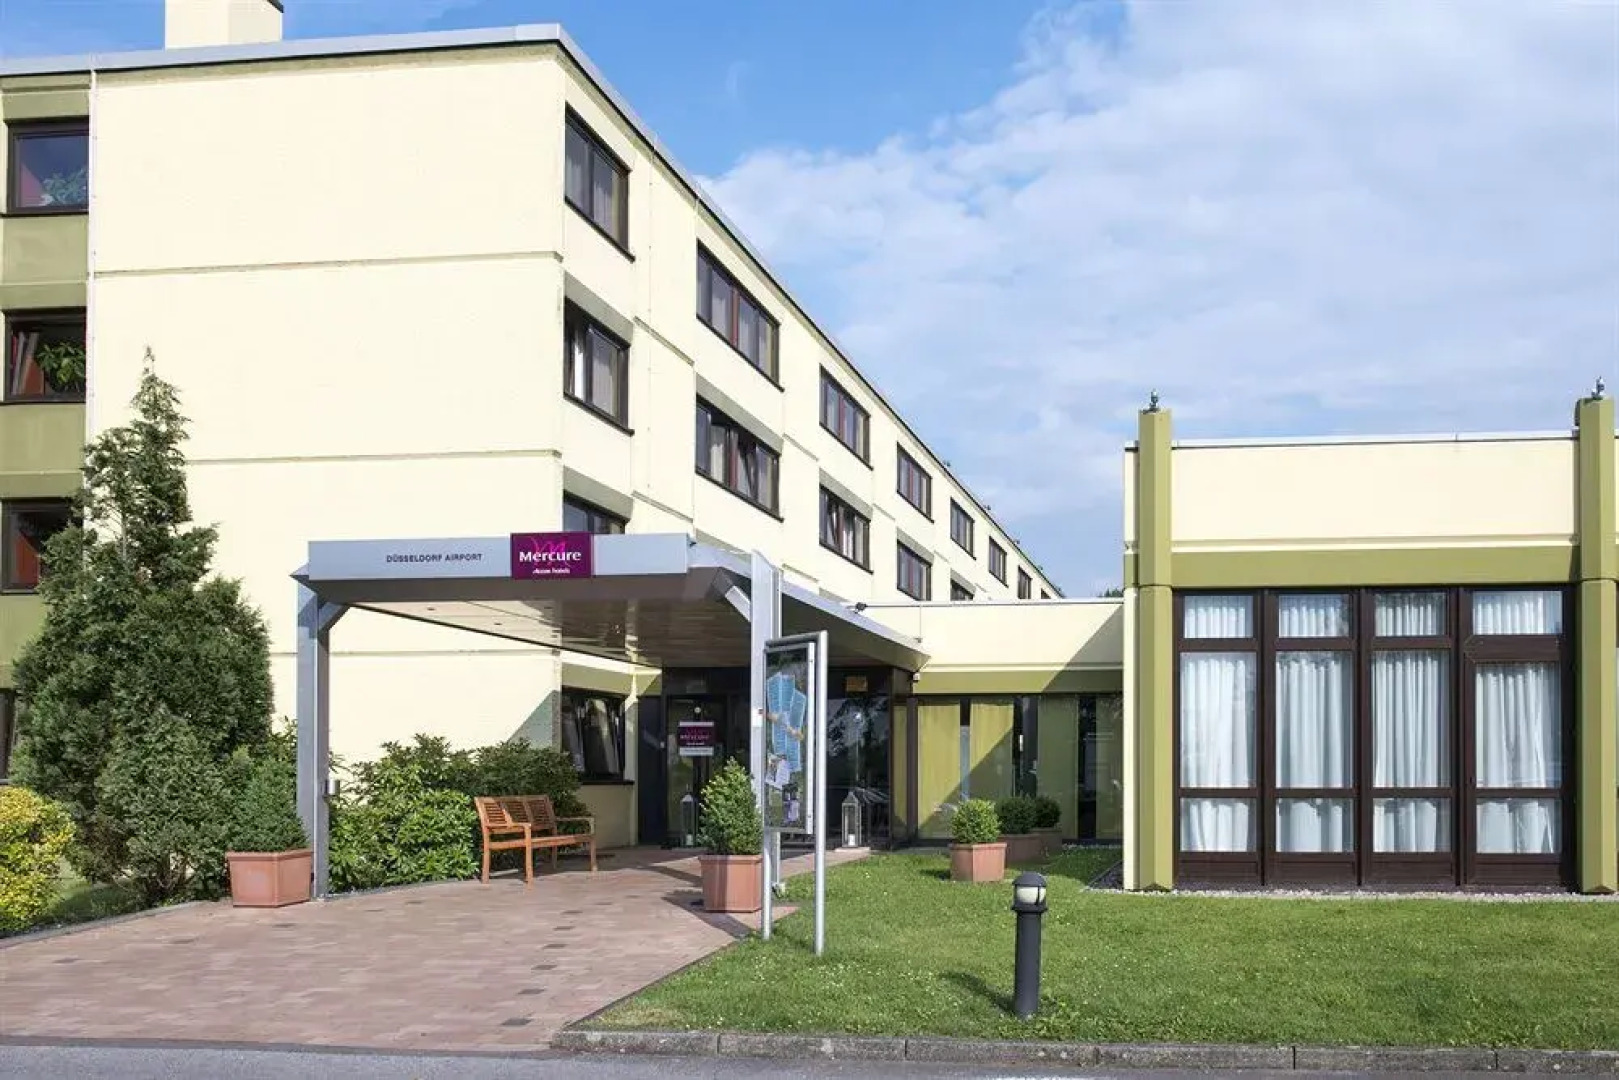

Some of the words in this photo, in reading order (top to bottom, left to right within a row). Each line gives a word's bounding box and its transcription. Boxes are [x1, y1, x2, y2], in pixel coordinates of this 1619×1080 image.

[386, 554, 442, 563] DÜSSELDORF
[444, 553, 483, 561] AIRPORT
[519, 551, 582, 563] Mercure
